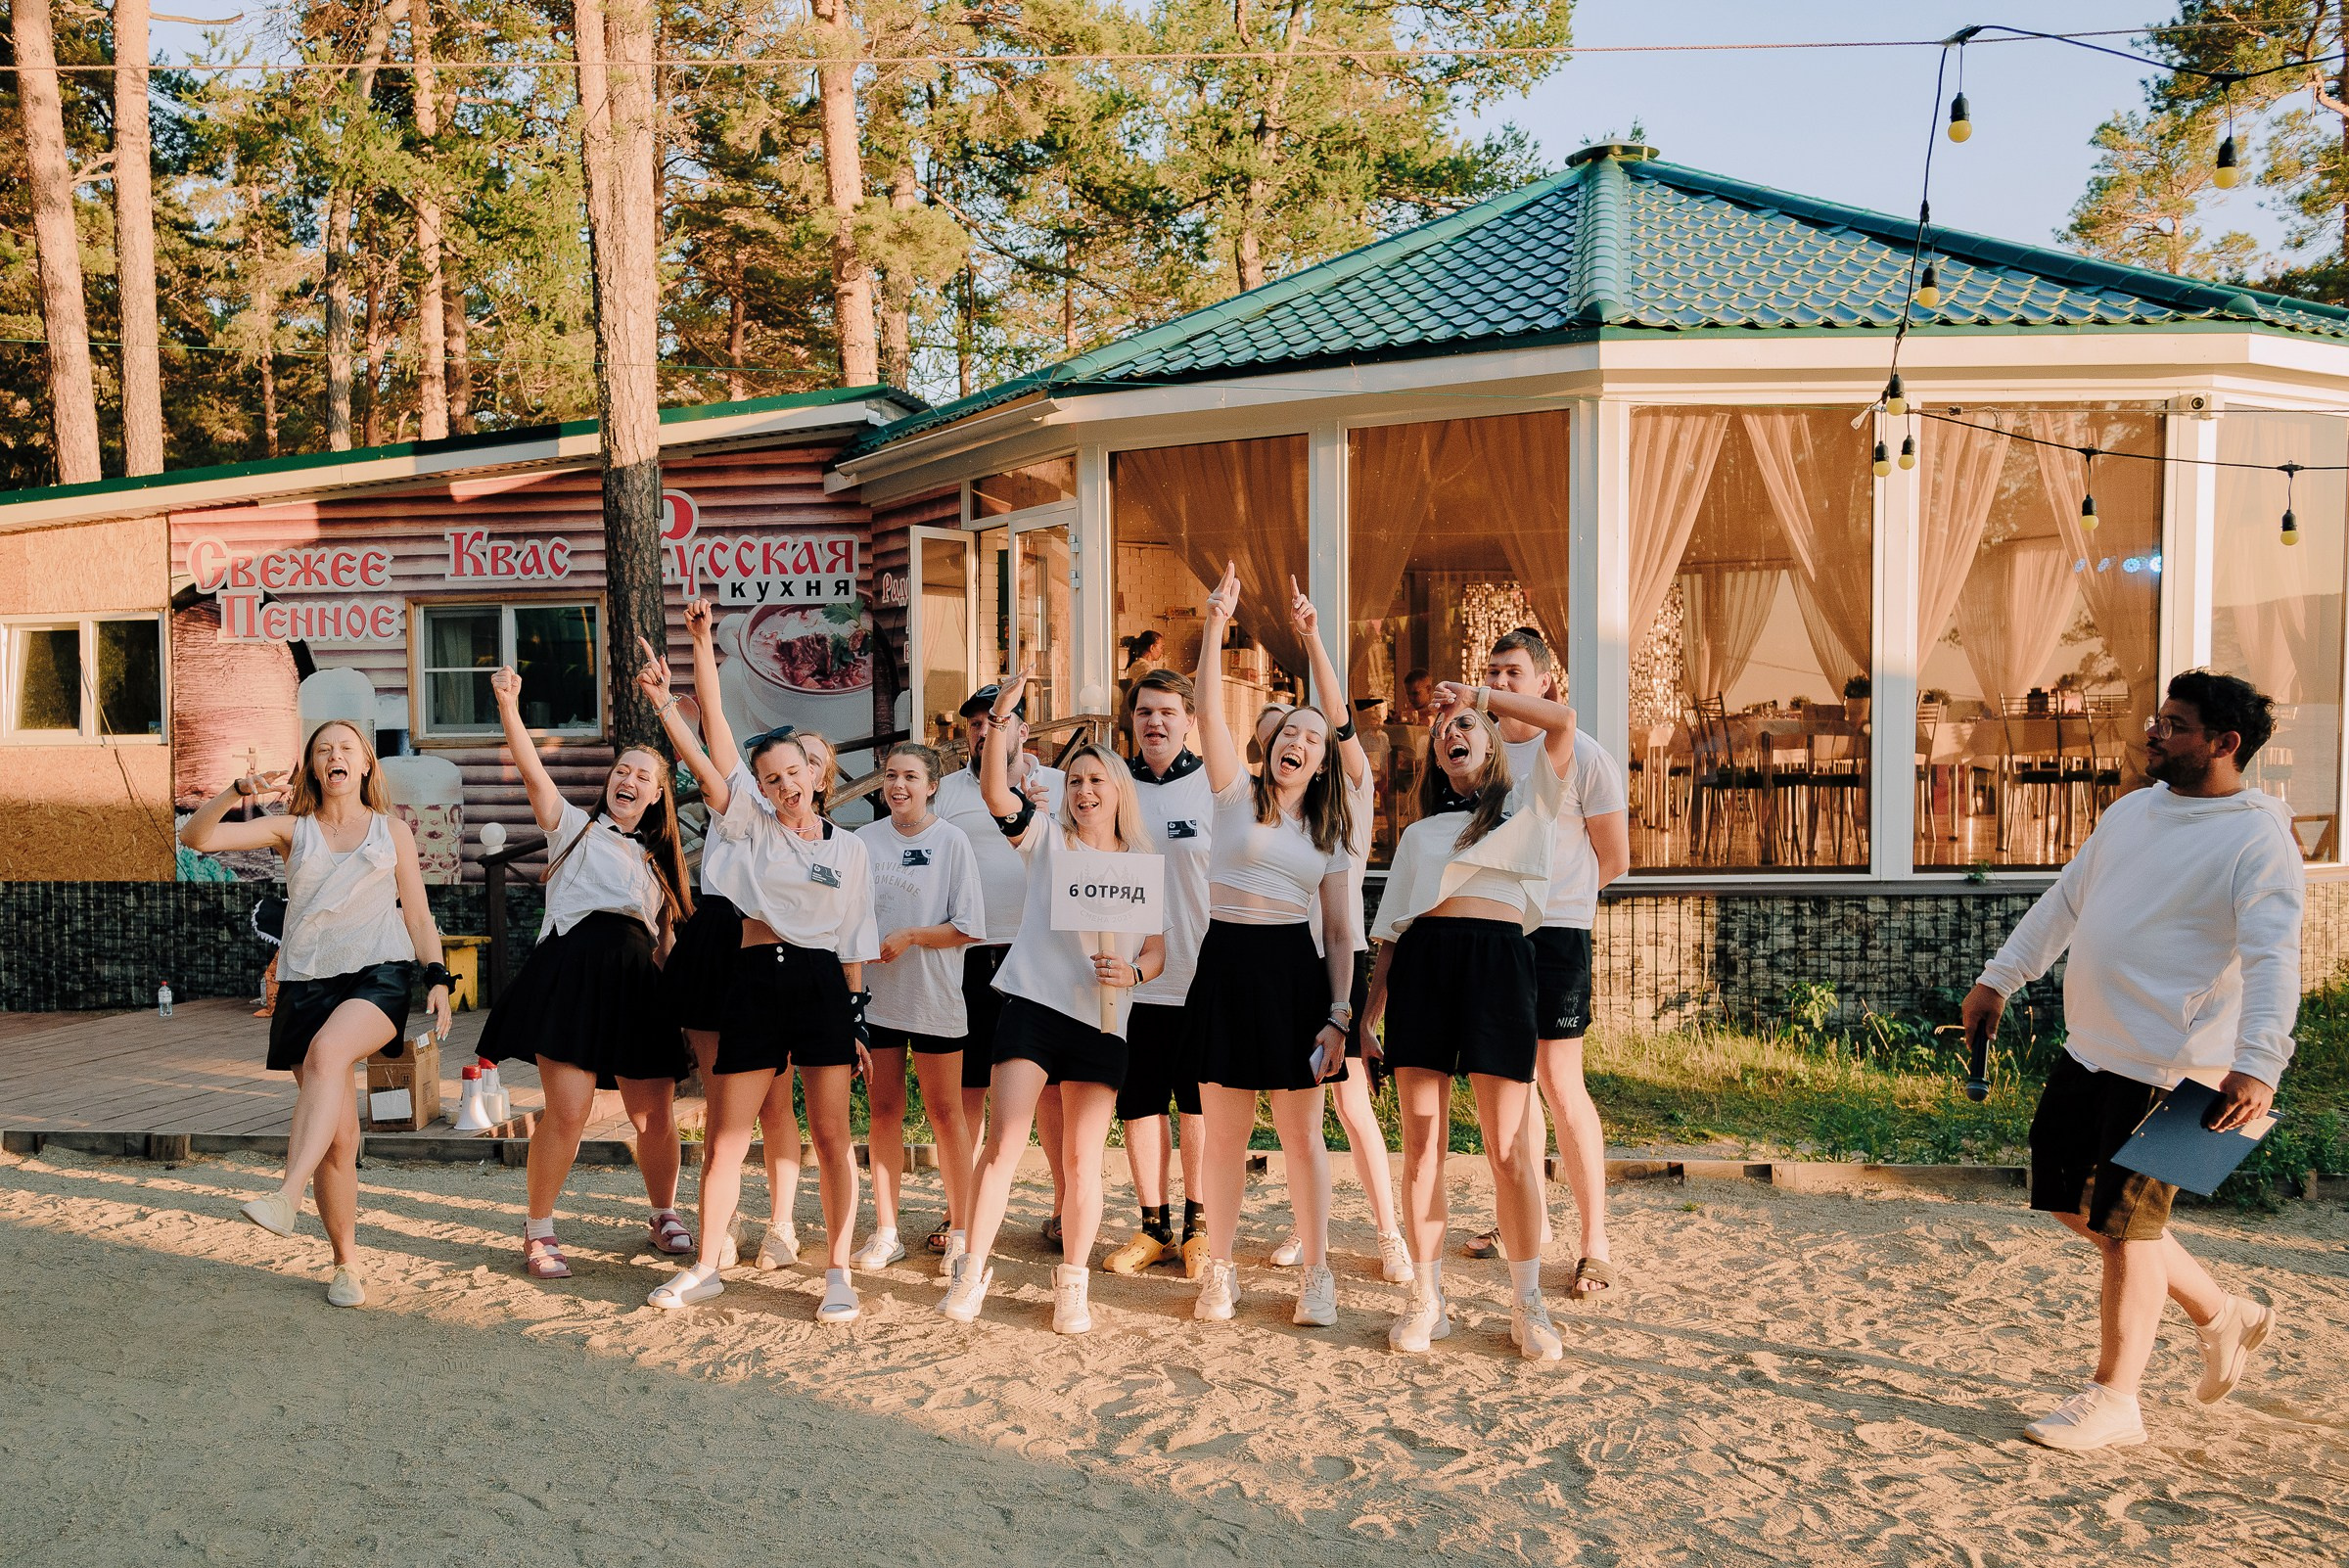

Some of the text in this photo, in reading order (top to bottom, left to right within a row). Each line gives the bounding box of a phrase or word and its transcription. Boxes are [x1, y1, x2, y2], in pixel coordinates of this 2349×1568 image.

[191, 540, 387, 590] Свежее
[449, 530, 569, 577] Квас
[730, 579, 851, 603] кухня
[883, 574, 909, 604] Рад
[221, 594, 395, 640] Пенное
[1069, 884, 1146, 904] 6 ОТРЯД
[1555, 1016, 1580, 1028] NIKE
